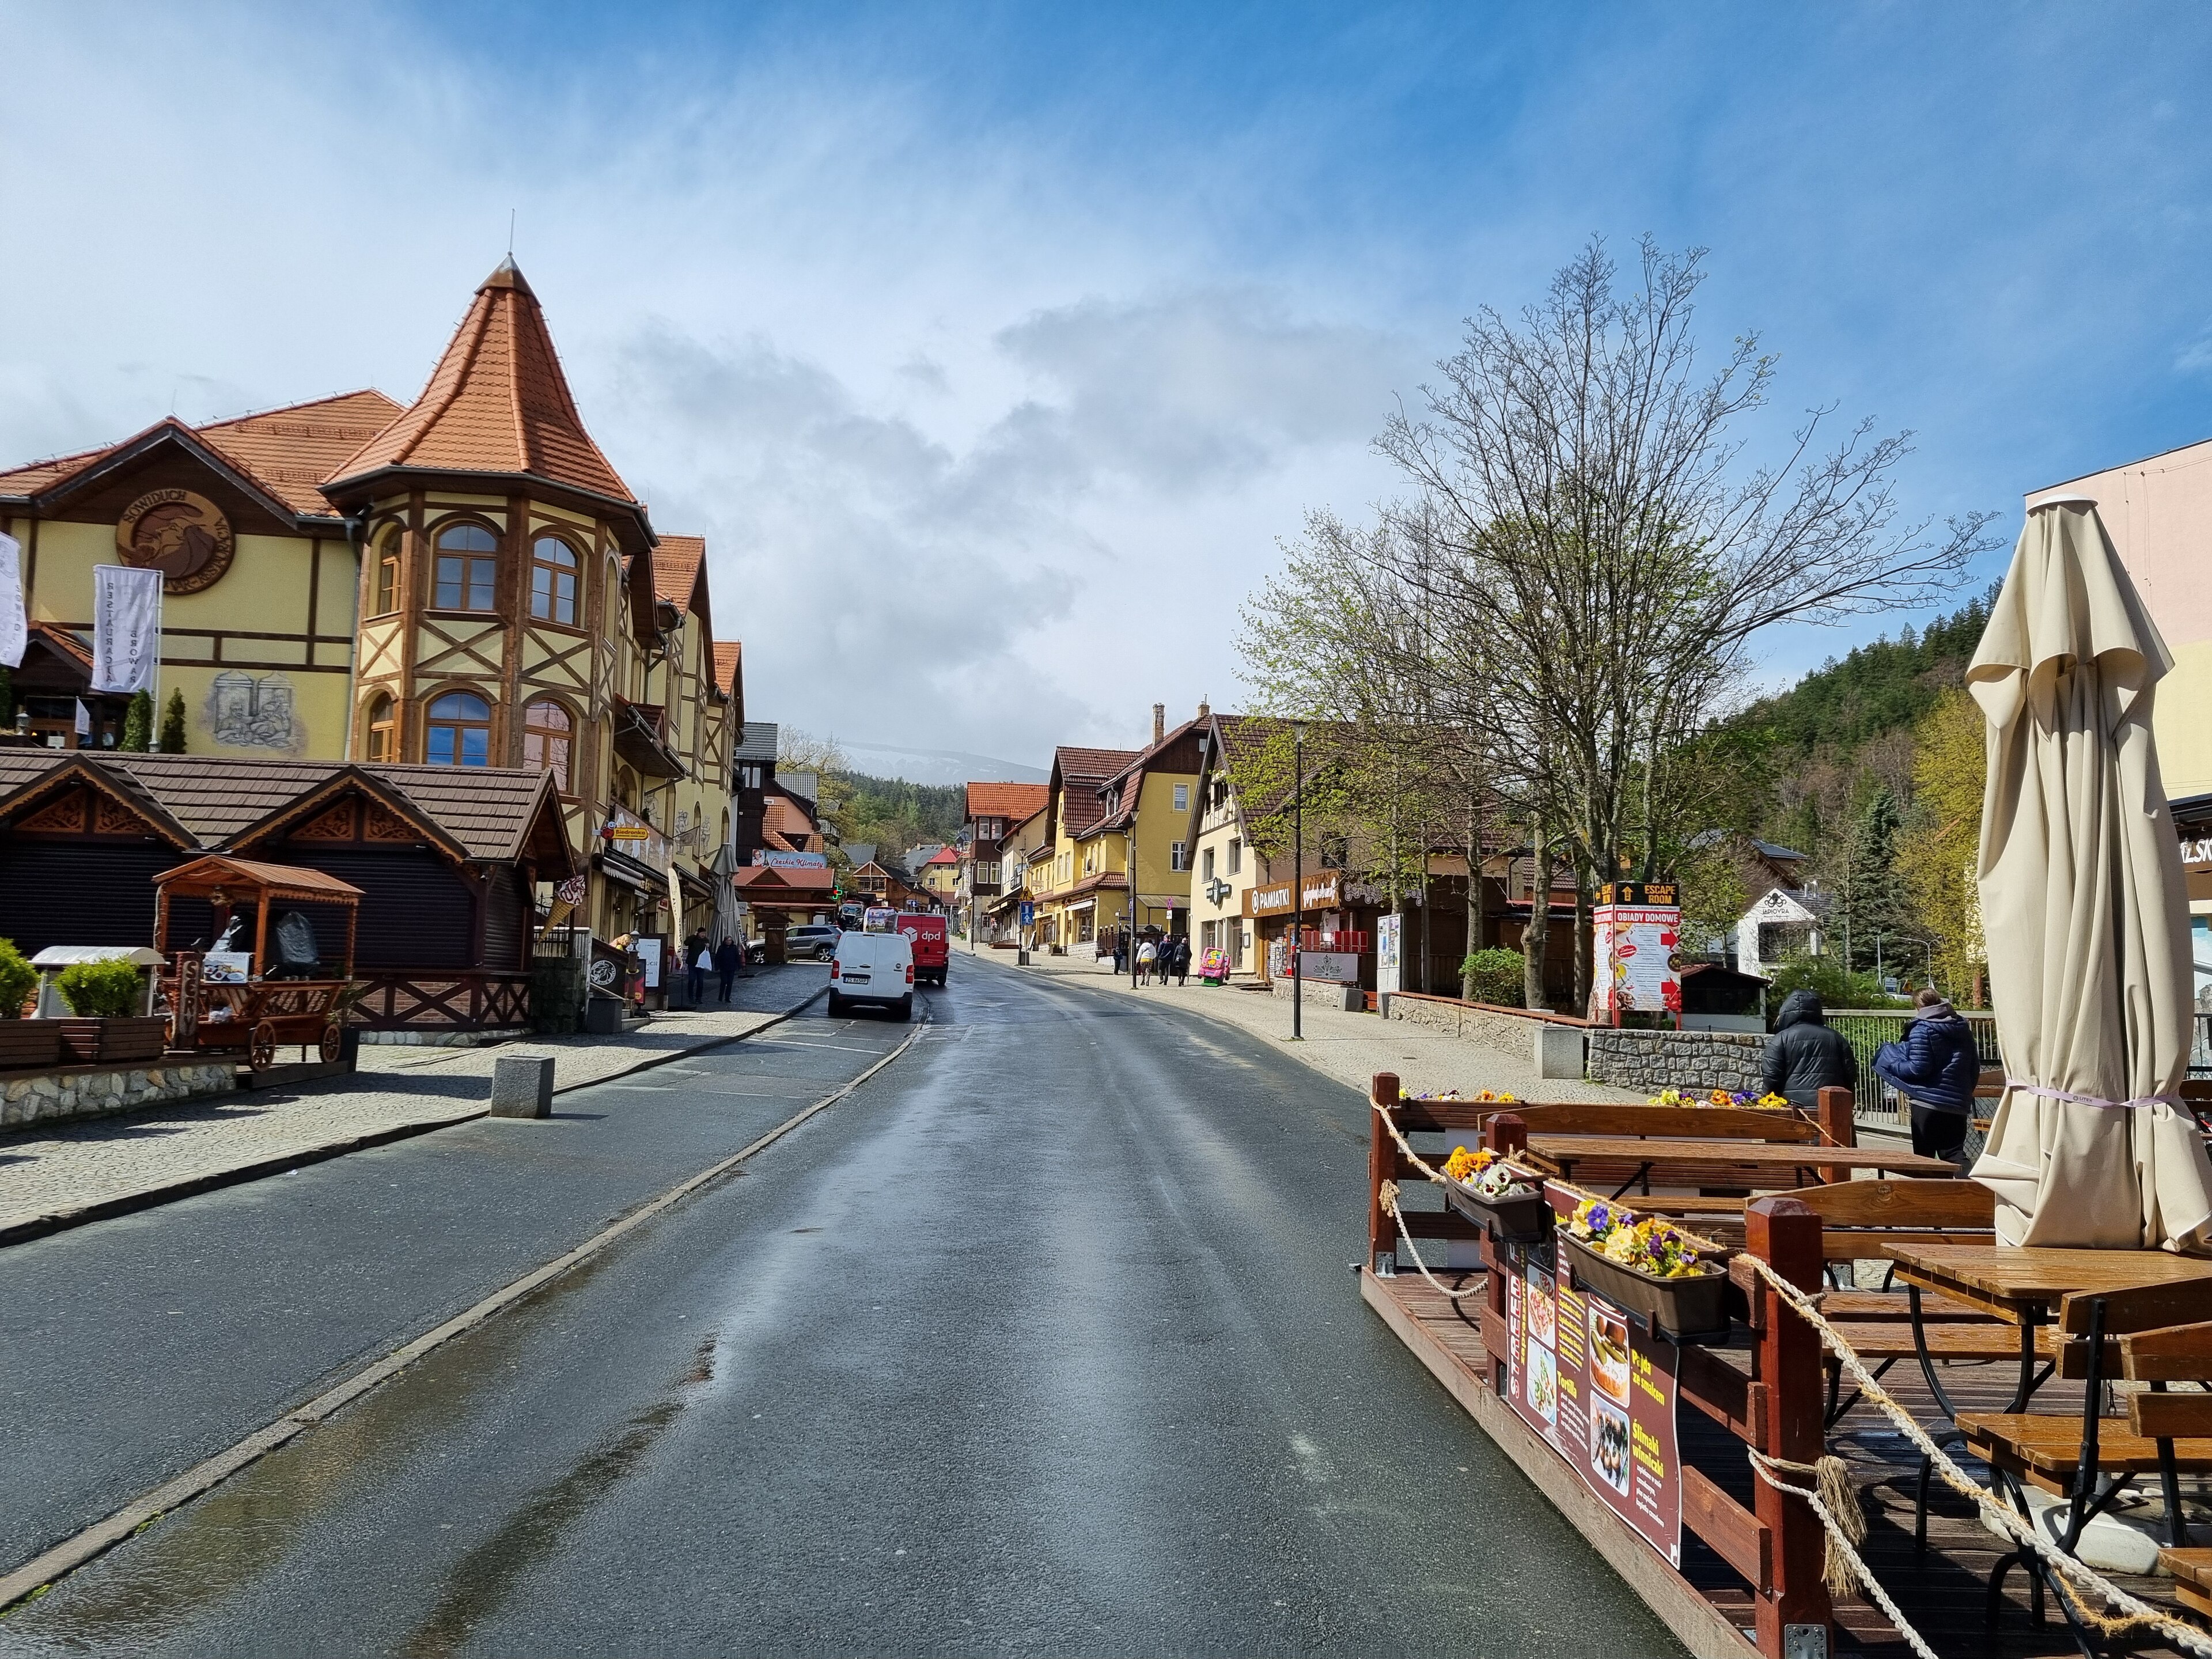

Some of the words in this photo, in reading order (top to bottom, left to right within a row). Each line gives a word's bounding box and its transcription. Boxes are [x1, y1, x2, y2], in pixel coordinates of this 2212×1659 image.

[1260, 888, 1289, 909] PAMIĄTKI
[1645, 885, 1676, 895] ESCAPE
[1649, 895, 1672, 904] ROOM
[1618, 912, 1643, 922] OBIADY
[1645, 913, 1678, 922] DOMOWE
[922, 931, 941, 942] dpd
[184, 961, 197, 1033] SERY
[1631, 1349, 1652, 1376] Pajda
[1557, 1370, 1577, 1399] Tortilla
[1633, 1372, 1641, 1386] ze
[1641, 1377, 1665, 1406] smalcem
[1632, 1418, 1660, 1456] Ślimaki
[1632, 1444, 1664, 1478] winniczki
